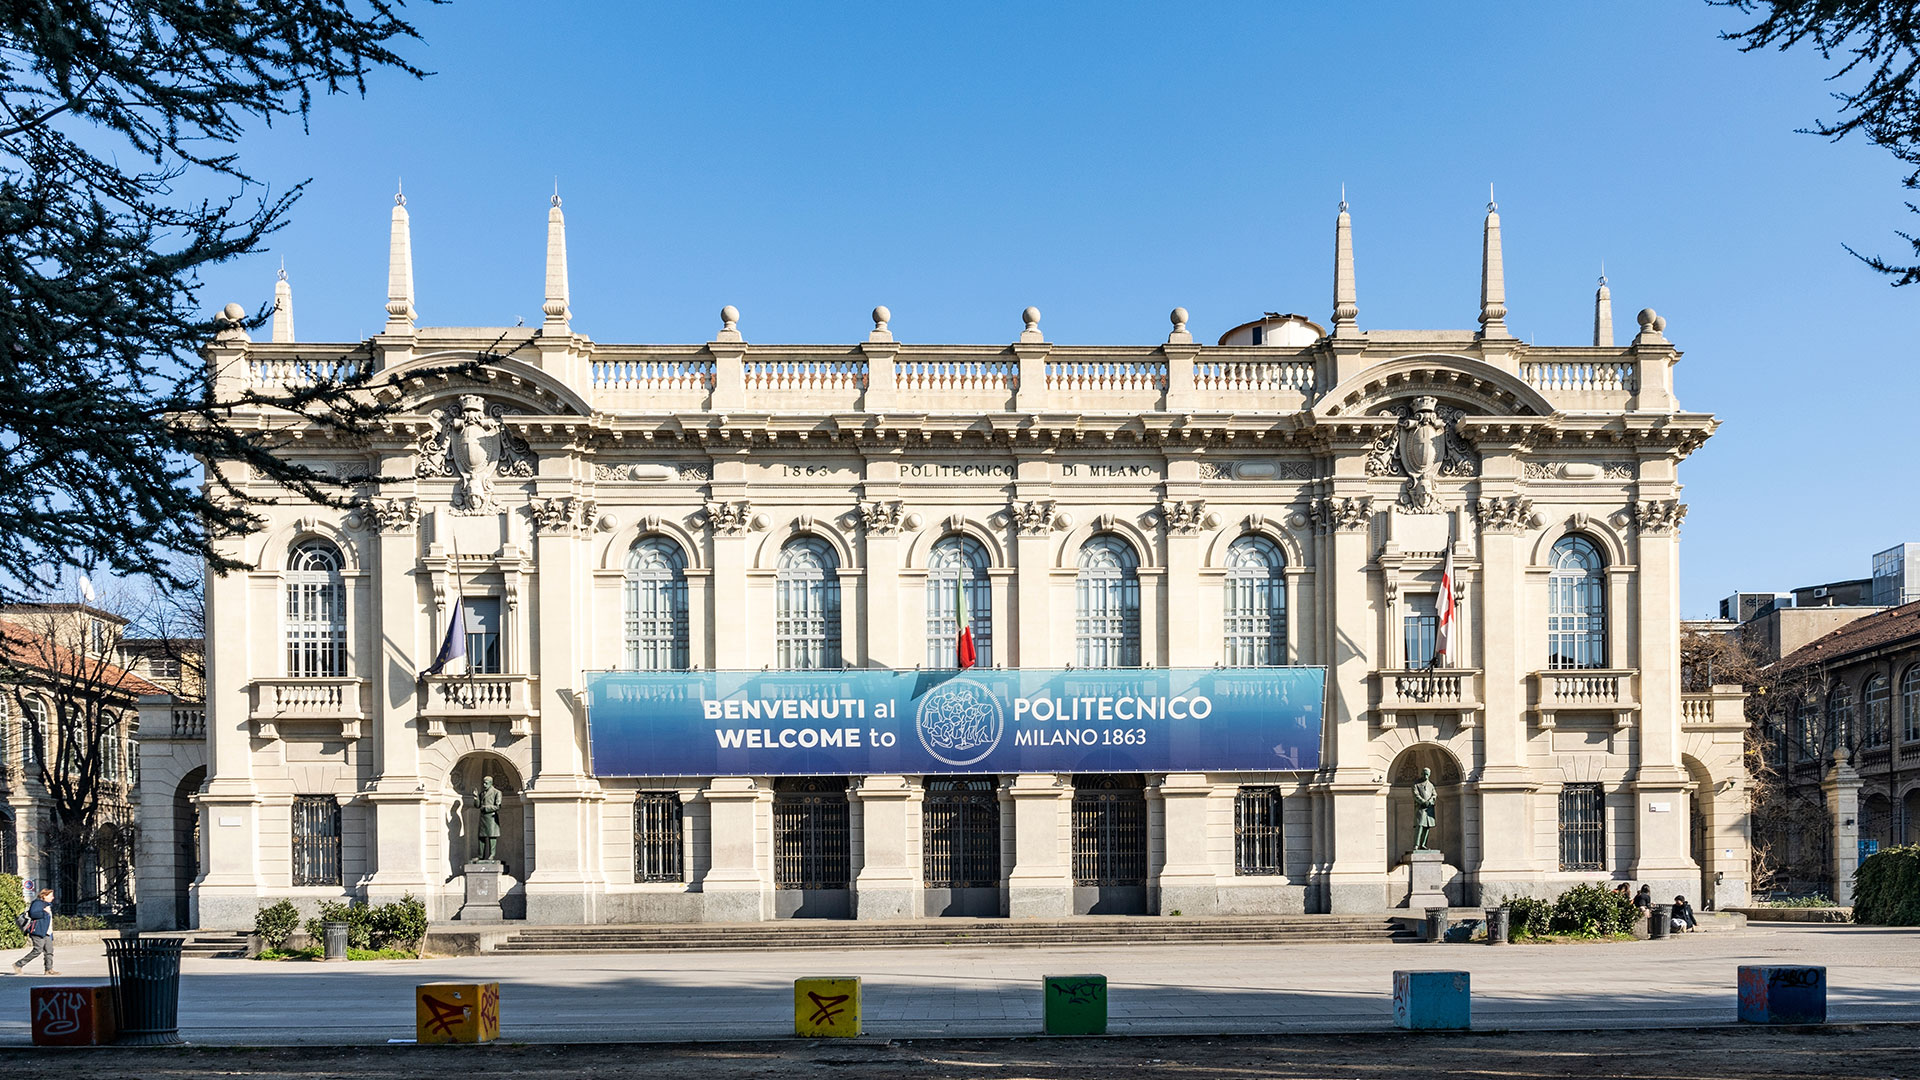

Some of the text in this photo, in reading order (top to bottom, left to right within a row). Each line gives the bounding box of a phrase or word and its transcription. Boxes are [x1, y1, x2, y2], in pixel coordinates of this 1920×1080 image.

[782, 464, 1151, 478] 1863 POLITECNICO DI MILANO
[703, 698, 895, 720] BENVENUTI al
[1013, 696, 1212, 722] POLITECNICO
[715, 727, 896, 749] WELCOME to
[1014, 728, 1147, 747] MILANO 1863
